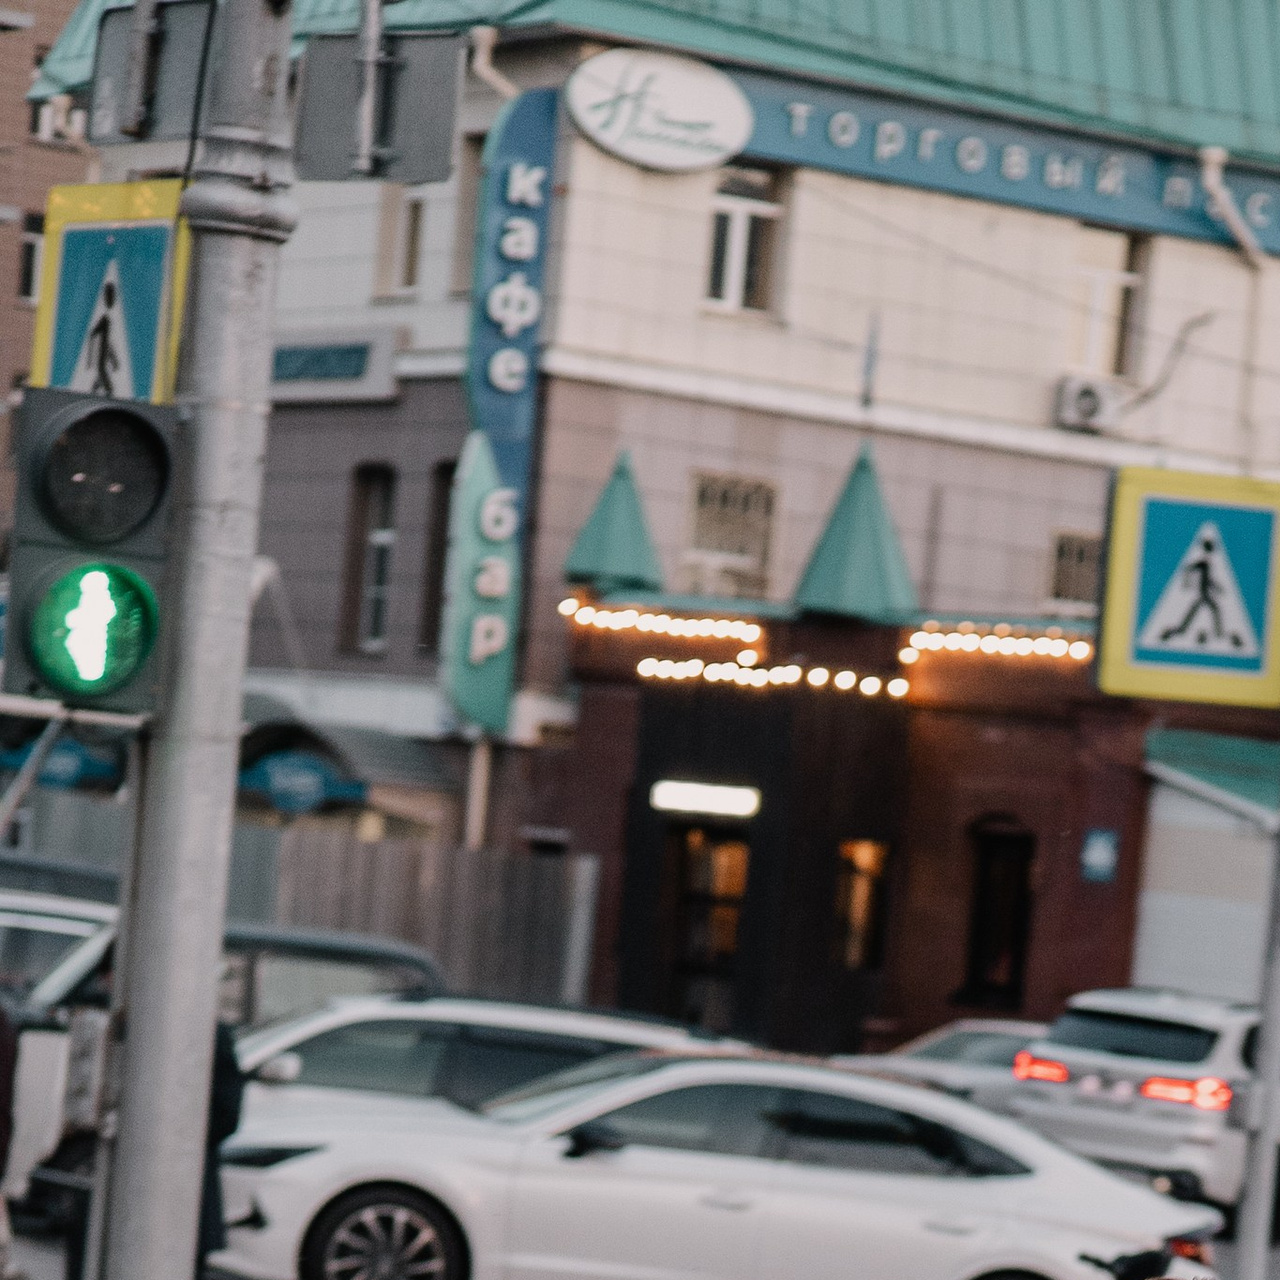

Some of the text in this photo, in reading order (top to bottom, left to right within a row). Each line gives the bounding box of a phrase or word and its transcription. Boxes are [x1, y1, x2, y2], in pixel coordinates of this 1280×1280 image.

[786, 103, 1127, 196] торговый
[487, 162, 548, 393] кафе
[469, 487, 521, 665] бар
